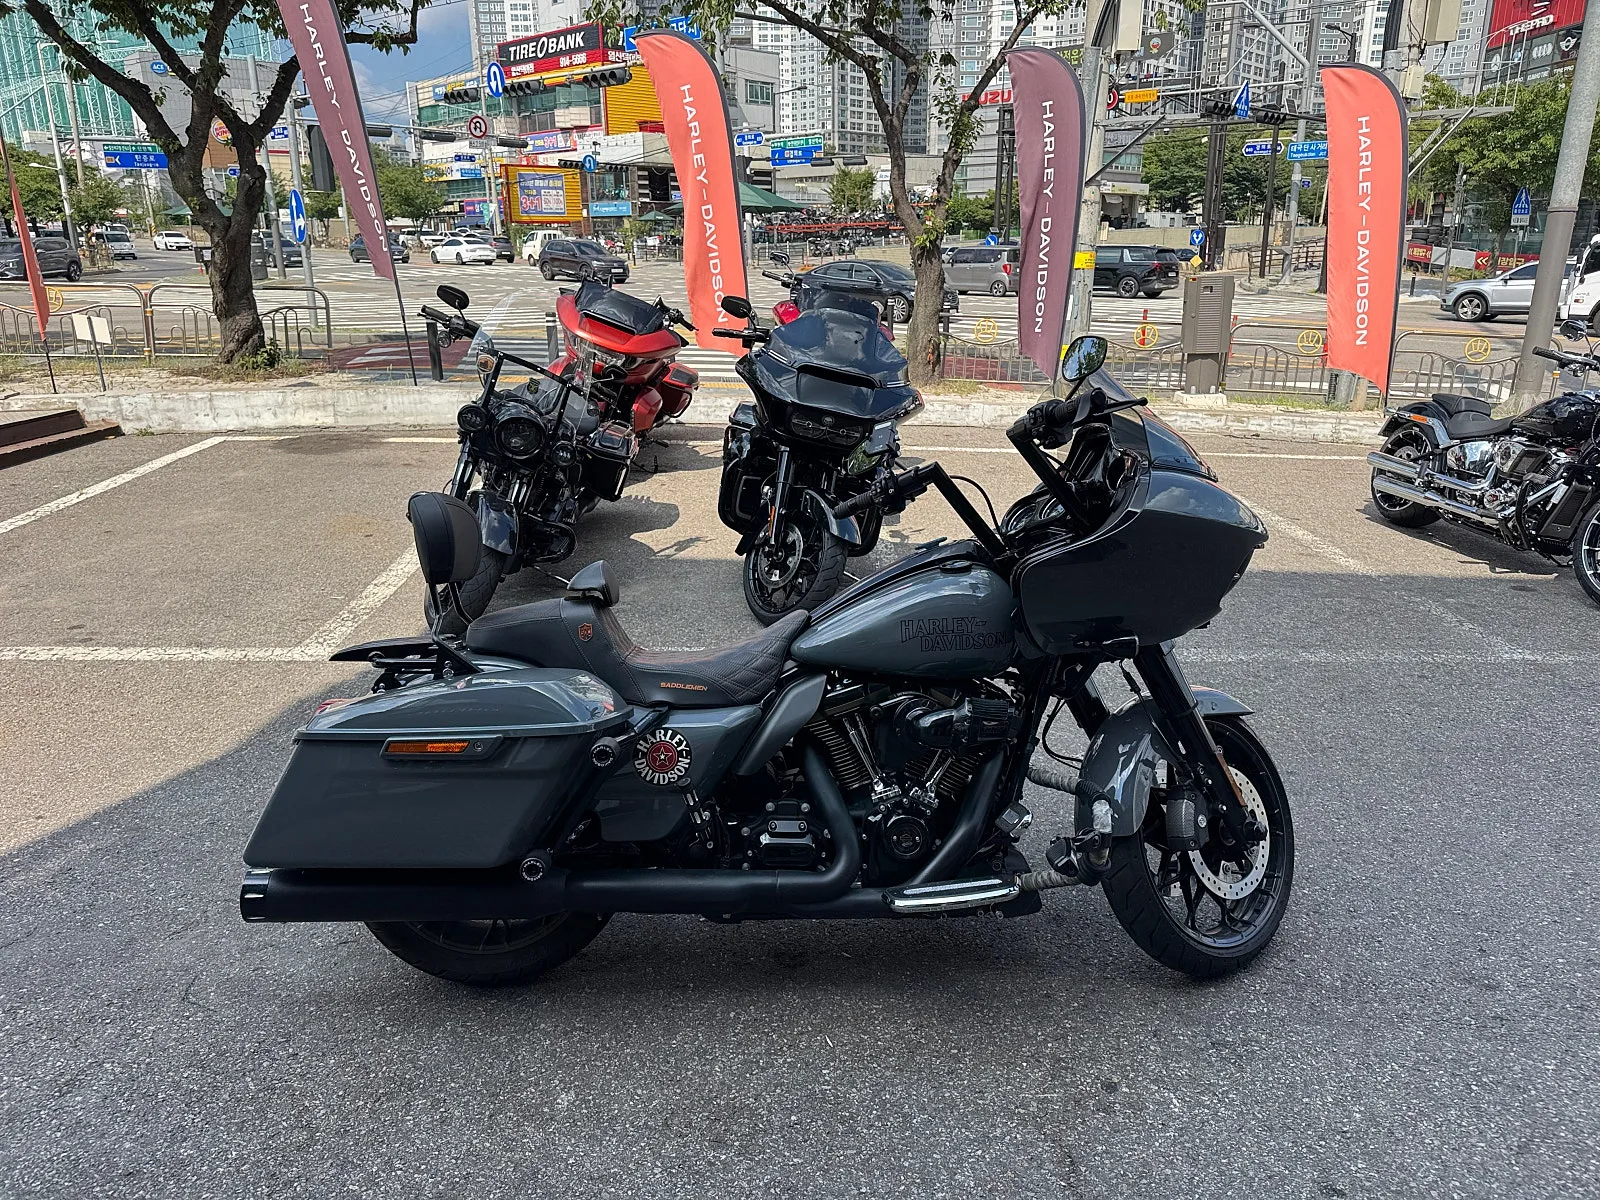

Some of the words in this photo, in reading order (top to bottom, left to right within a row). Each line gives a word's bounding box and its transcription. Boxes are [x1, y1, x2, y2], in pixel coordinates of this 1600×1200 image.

[520, 195, 542, 212] 3+1
[920, 631, 1007, 653] DAVIDSON
[660, 682, 708, 693] SADDLEMEN
[636, 729, 690, 753] HARLEY
[634, 757, 691, 785] DAVIDSON
